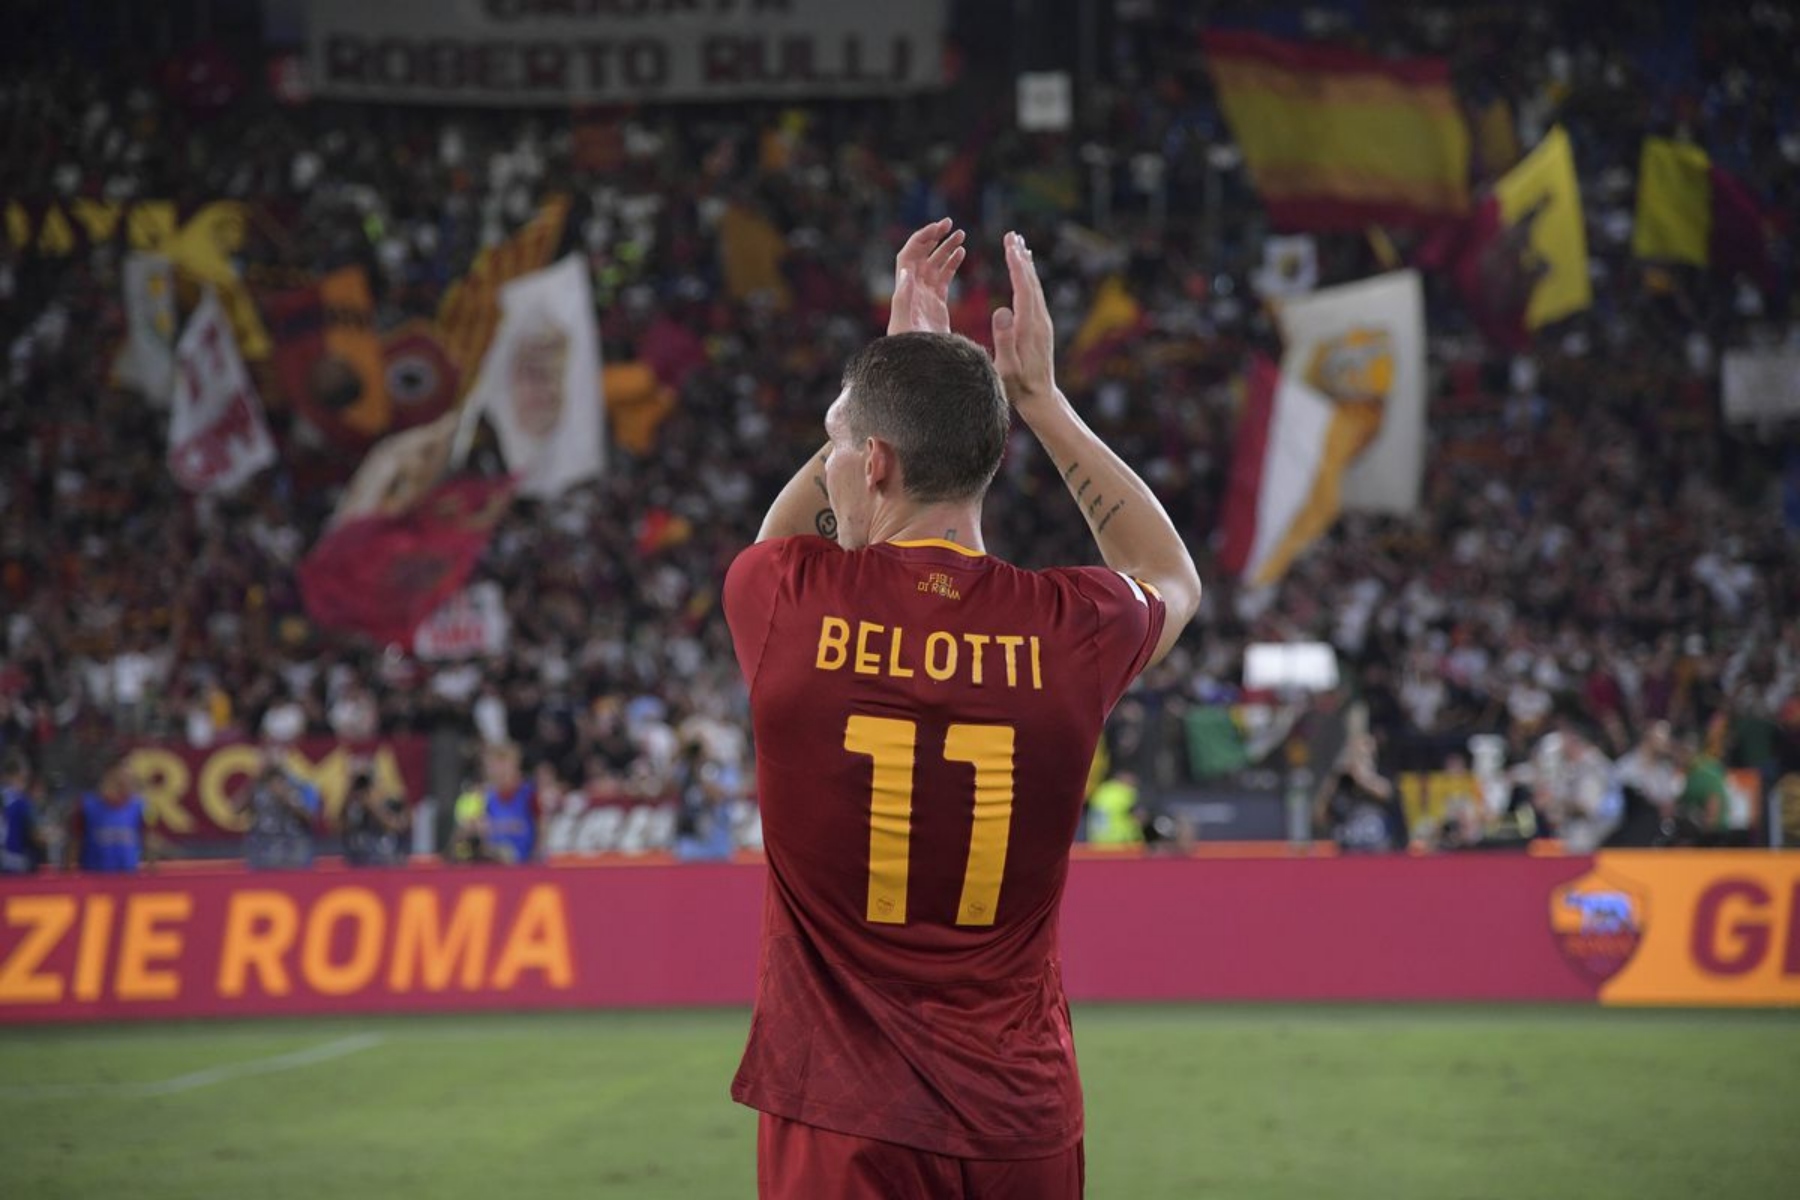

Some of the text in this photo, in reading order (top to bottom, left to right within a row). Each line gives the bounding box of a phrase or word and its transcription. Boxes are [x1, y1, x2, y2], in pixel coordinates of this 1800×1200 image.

[325, 33, 914, 89] ROBERTO RULLI
[815, 616, 1043, 689] BELOTTI
[843, 715, 1015, 926] 11
[0, 884, 574, 1002] ZIE ROMA
[1688, 873, 1800, 980] G
